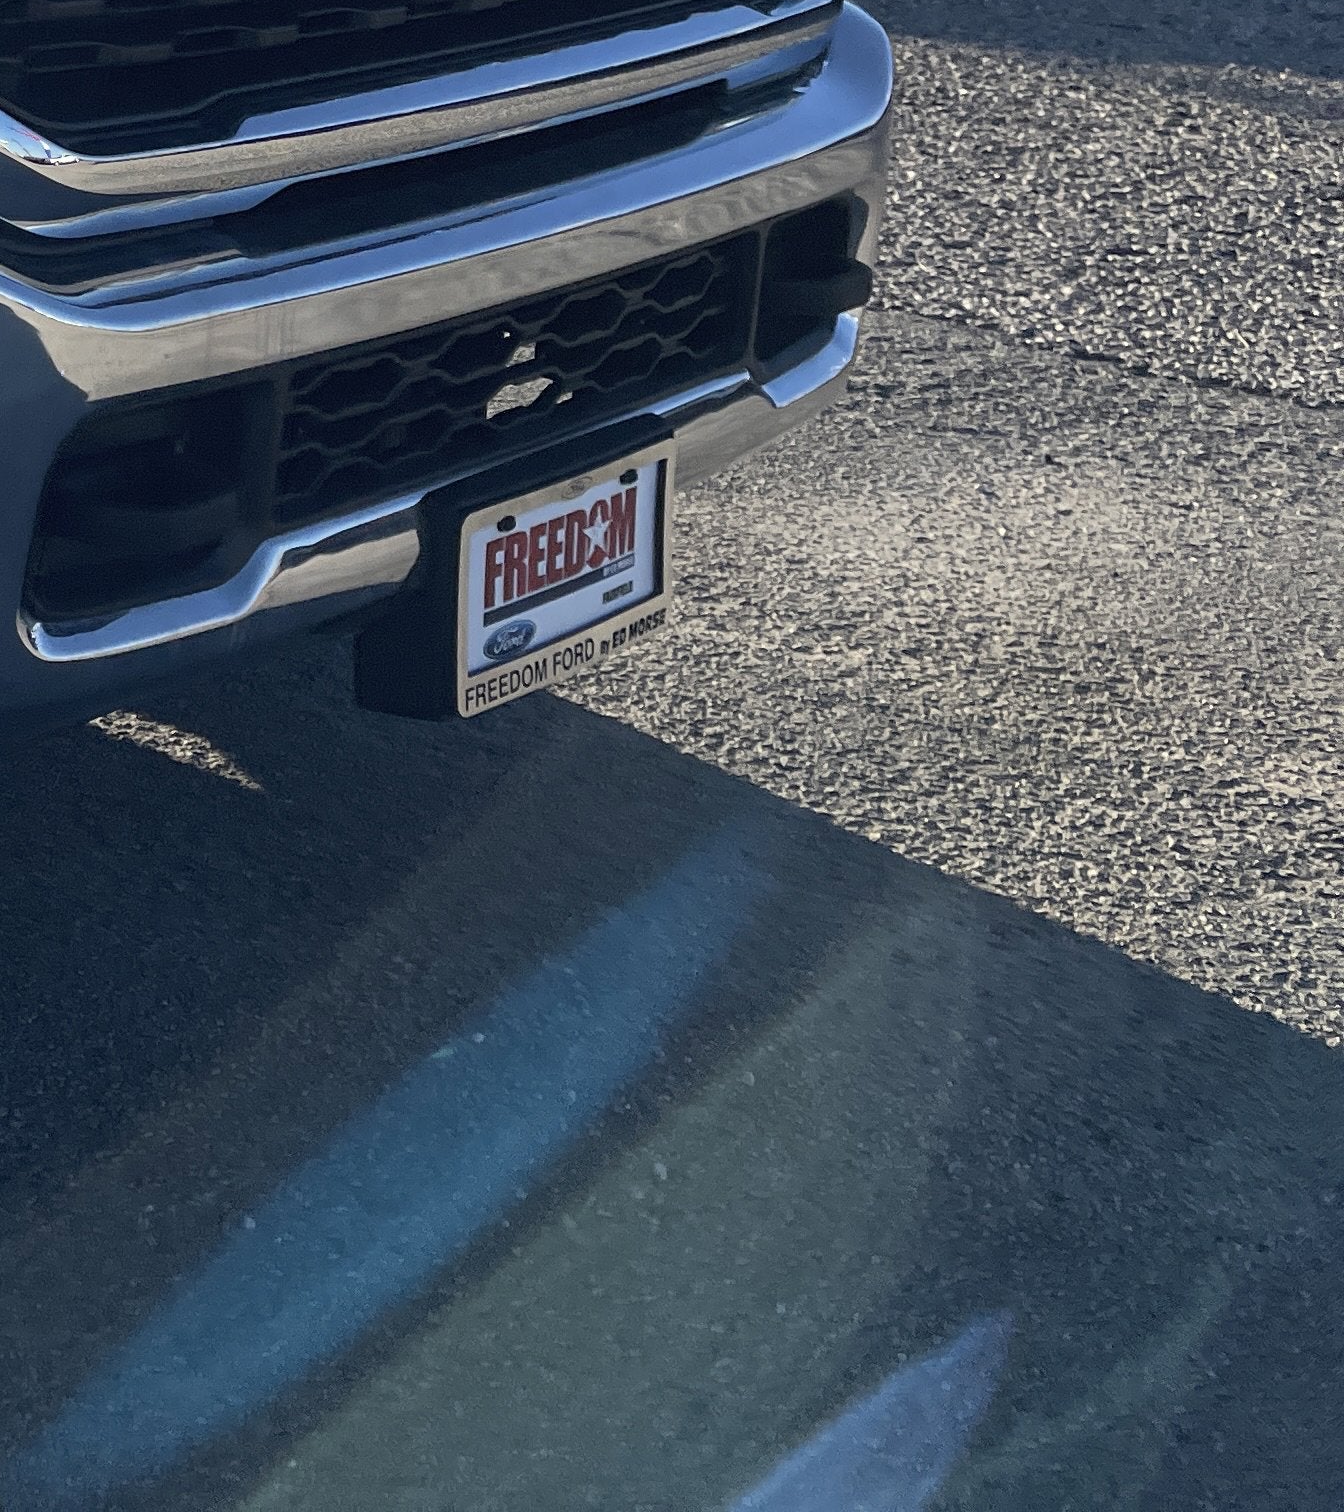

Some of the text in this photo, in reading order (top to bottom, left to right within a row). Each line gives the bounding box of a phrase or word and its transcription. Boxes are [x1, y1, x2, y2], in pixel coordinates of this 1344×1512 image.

[484, 486, 638, 609] FREEDOM
[465, 657, 548, 712] FREEDOM
[552, 637, 595, 676] FORD
[612, 628, 627, 649] ED
[628, 608, 668, 642] MORSE
